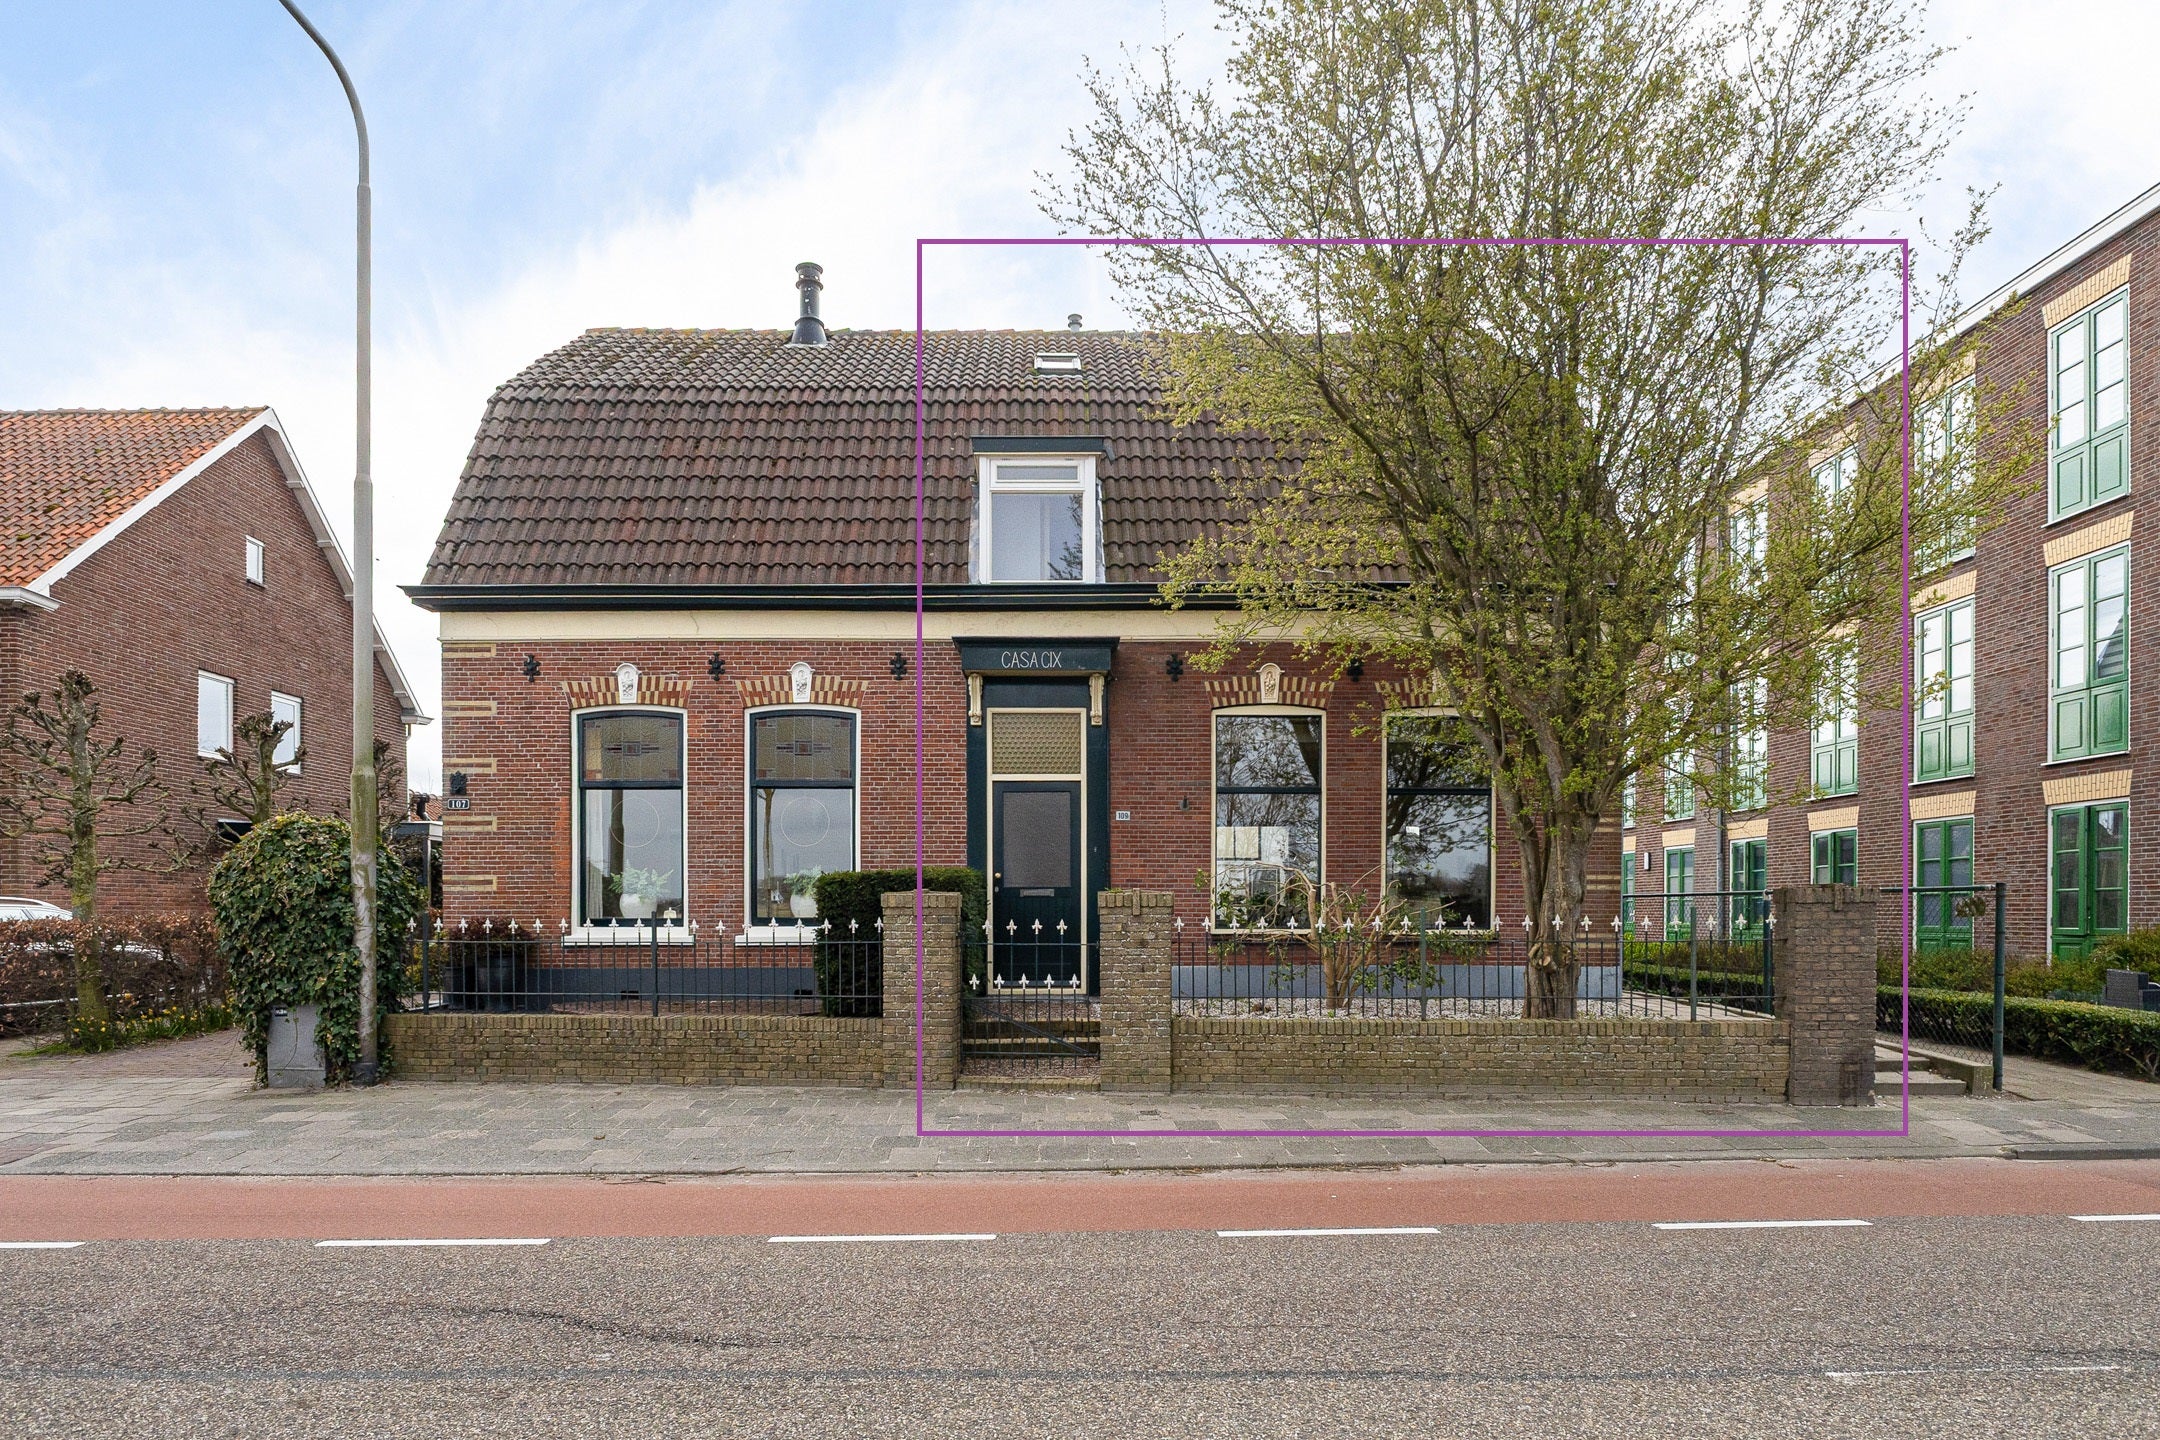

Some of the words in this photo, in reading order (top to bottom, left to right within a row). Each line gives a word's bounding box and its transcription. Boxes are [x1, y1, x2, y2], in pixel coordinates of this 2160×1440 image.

[1001, 651, 1039, 668] CASA
[1041, 651, 1062, 668] CIX
[451, 800, 466, 808] 107
